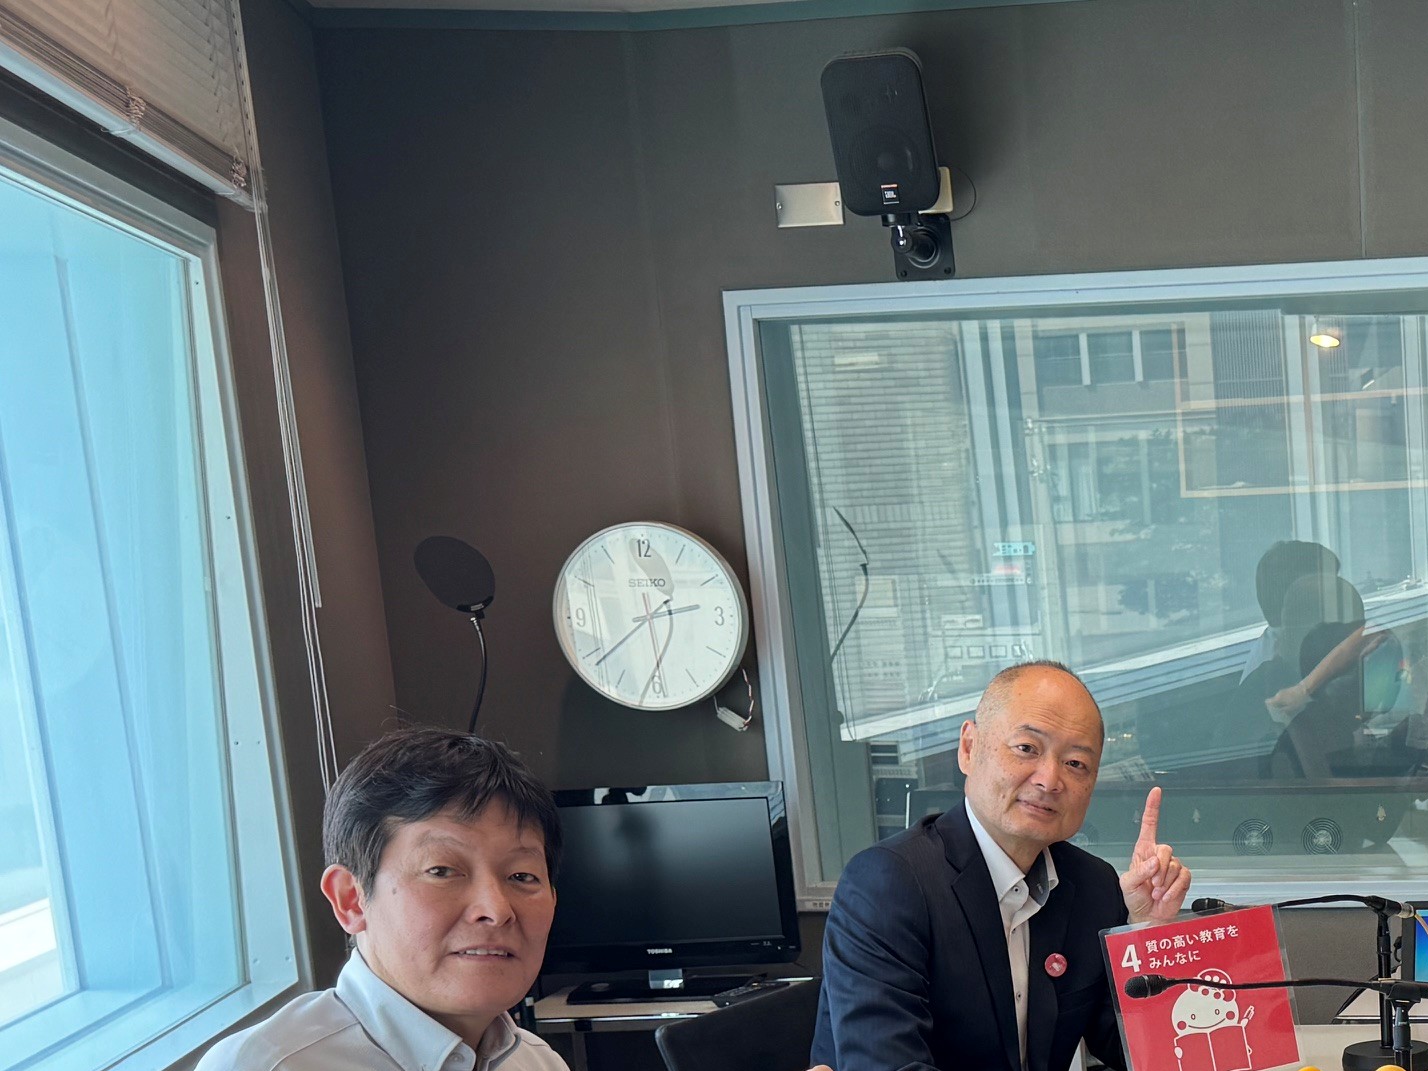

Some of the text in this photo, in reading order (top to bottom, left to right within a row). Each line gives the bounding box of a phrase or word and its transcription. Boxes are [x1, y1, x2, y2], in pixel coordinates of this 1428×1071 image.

[636, 538, 652, 558] 12
[628, 578, 666, 588] SEIKO
[576, 607, 586, 628] 9
[714, 606, 725, 626] 3
[652, 674, 662, 695] 6
[1120, 924, 1240, 973] 4 質の高い教育を
[1148, 950, 1202, 970] みんなに
